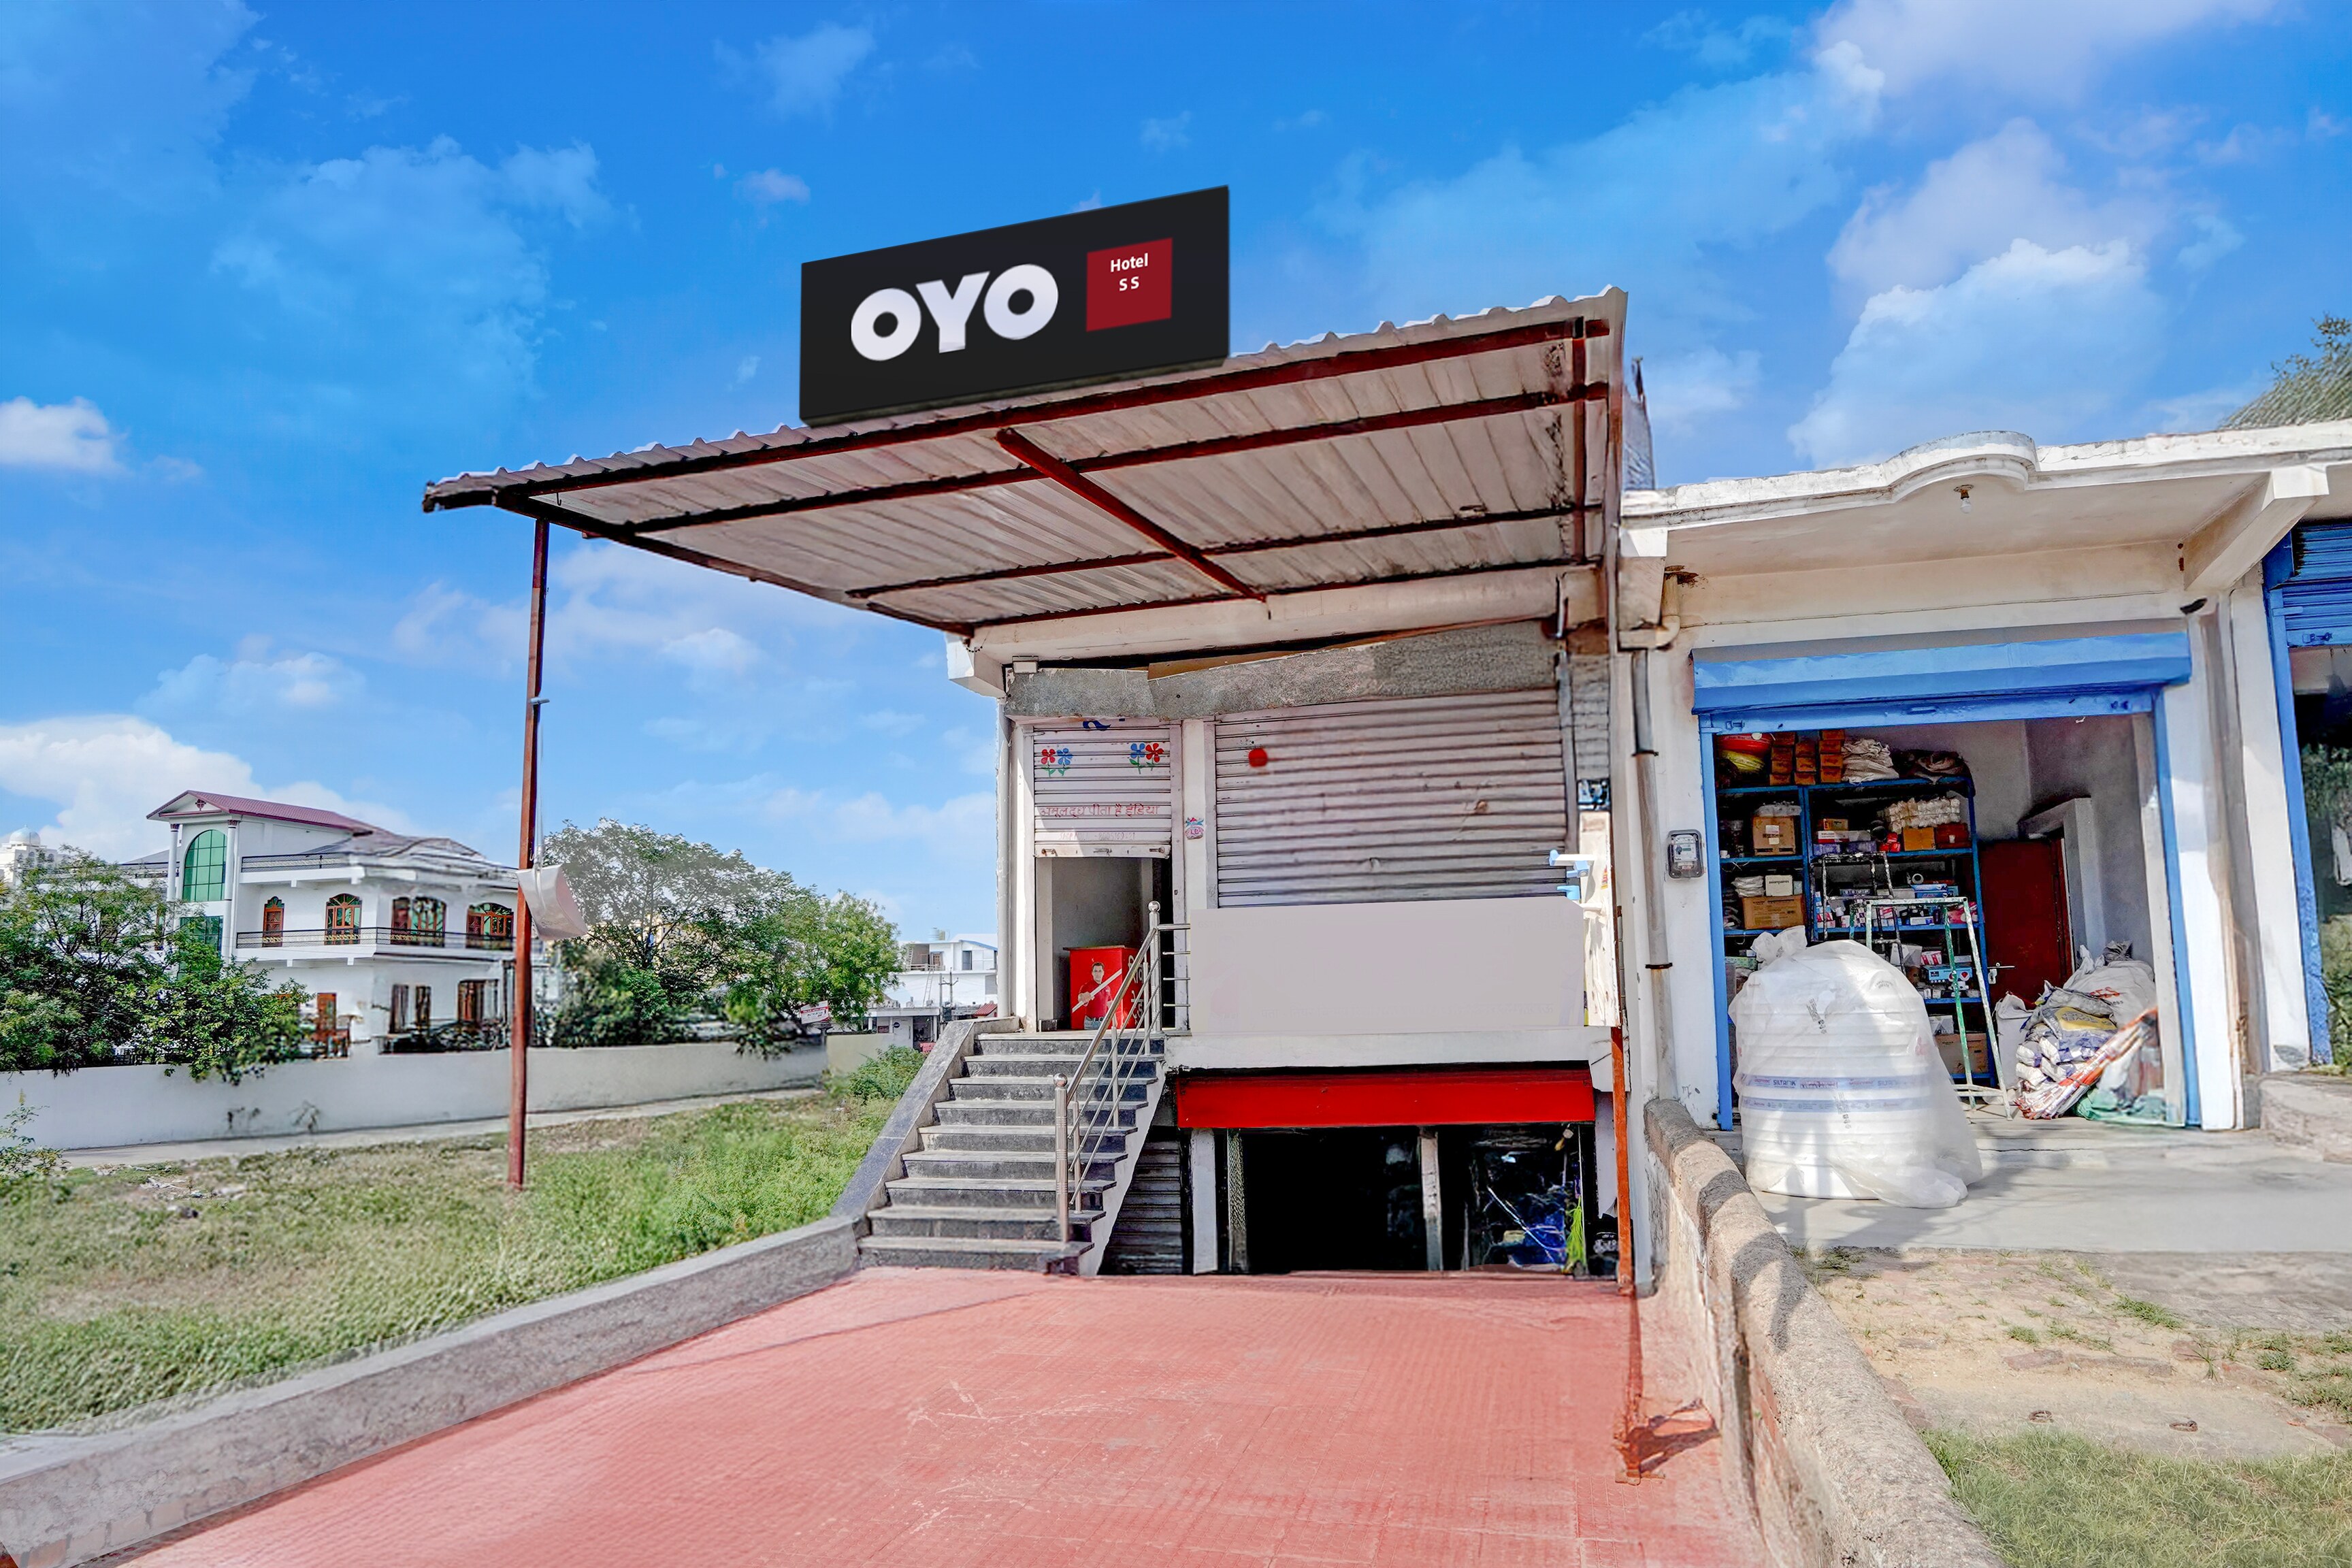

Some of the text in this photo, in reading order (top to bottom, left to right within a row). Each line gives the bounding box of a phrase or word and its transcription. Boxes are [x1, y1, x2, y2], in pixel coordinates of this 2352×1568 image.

[1110, 252, 1149, 273] Hotel
[851, 263, 1058, 361] OYO
[1039, 806, 1068, 818] अमूल
[1089, 804, 1111, 816] पीता
[1115, 804, 1122, 817] है
[1125, 804, 1160, 817] इंडिया
